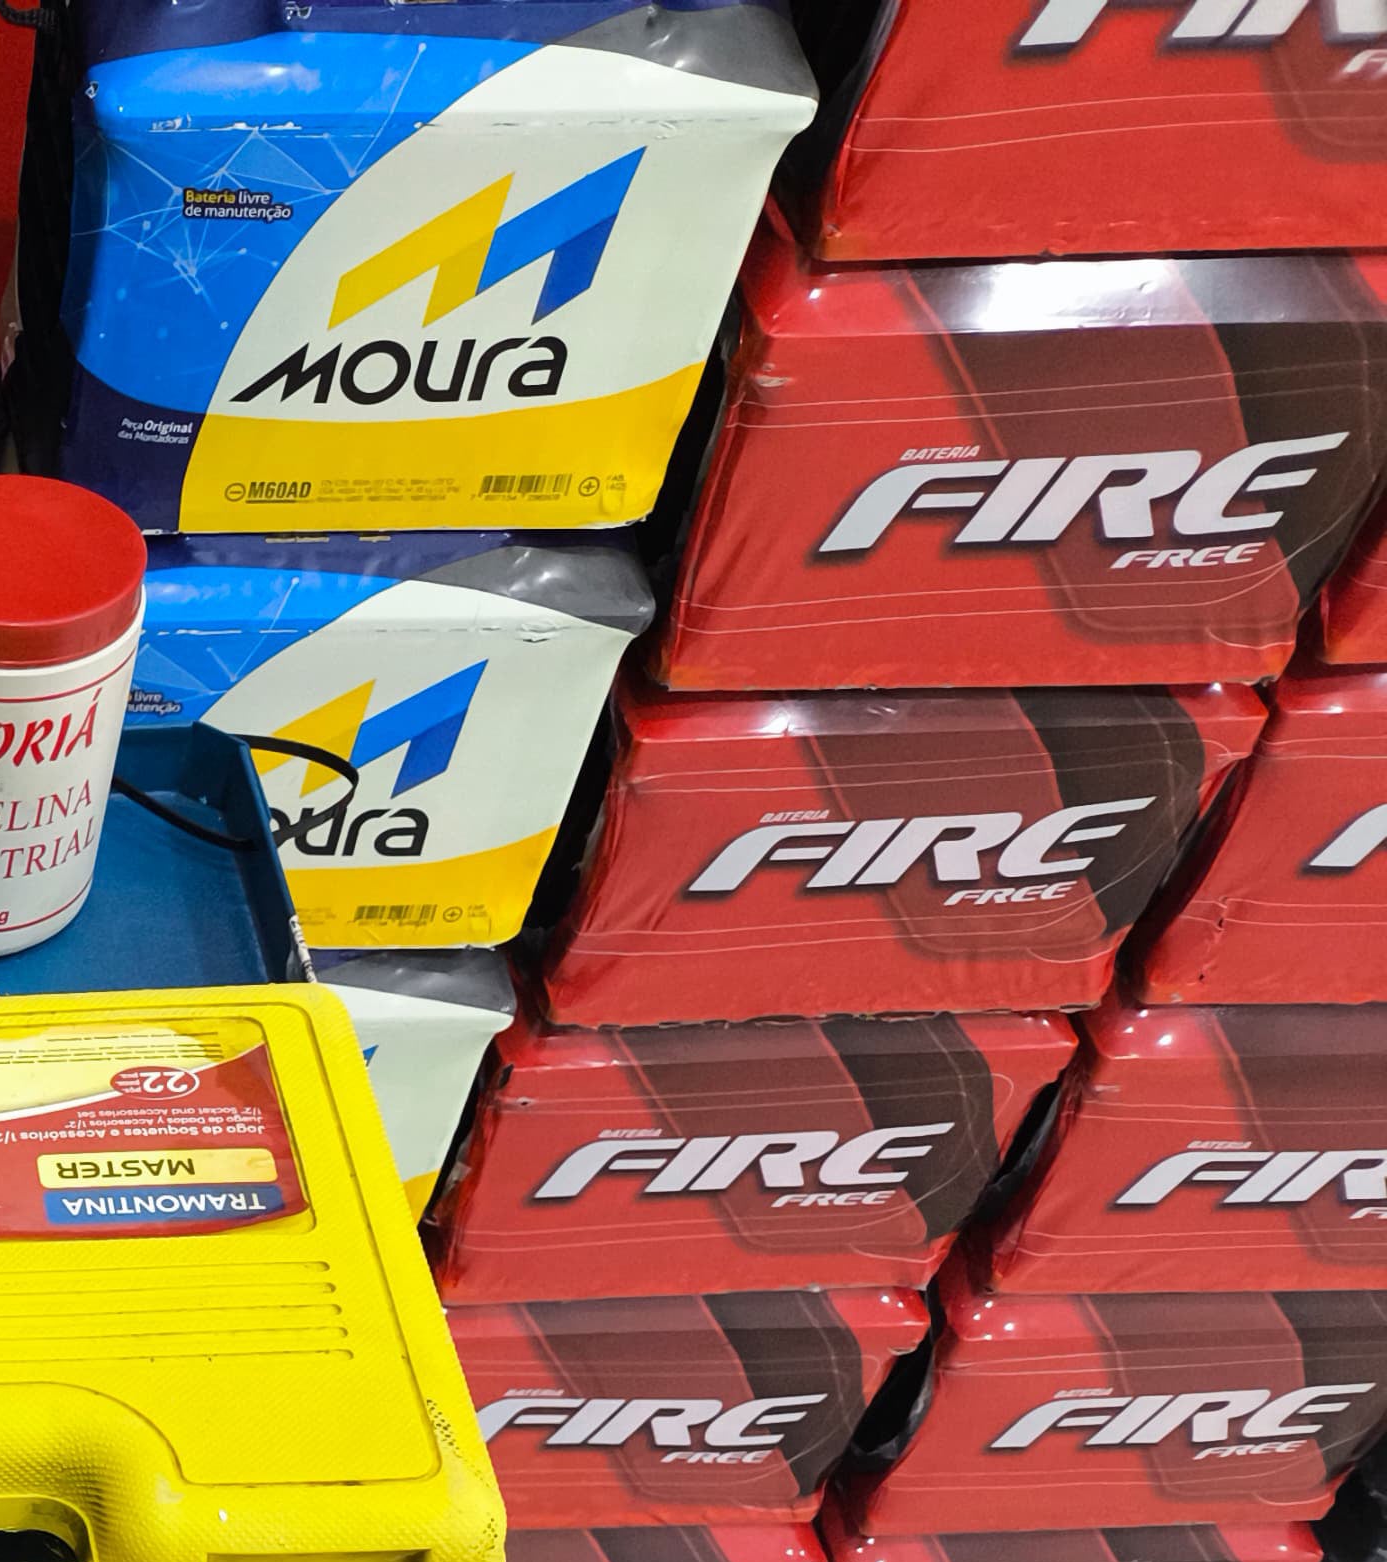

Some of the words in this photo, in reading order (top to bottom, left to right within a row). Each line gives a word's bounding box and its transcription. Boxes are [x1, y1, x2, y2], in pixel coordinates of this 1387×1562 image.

[184, 189, 235, 204] Bateria
[237, 190, 271, 204] livre
[184, 204, 202, 217] de
[205, 205, 291, 222] manutenção
[144, 419, 192, 436] Original
[899, 445, 981, 462] BATERIA
[248, 481, 312, 499] M60AD
[819, 431, 1350, 552] FIRE
[1111, 542, 1265, 569] FREE
[759, 809, 829, 824] BATERIA
[689, 796, 1157, 892] FIRE
[944, 881, 1077, 906] FREE
[139, 1070, 189, 1094] 22
[20, 1128, 107, 1143] Acessórios
[123, 1124, 199, 1138] Soquetes
[202, 1126, 223, 1136] de
[225, 1124, 266, 1135] Jogo
[56, 1158, 196, 1179] MASTER
[534, 1122, 955, 1199] FIRE
[61, 1192, 267, 1217] TRAMONTINA
[771, 1190, 896, 1208] FREE
[477, 1393, 829, 1447] FIRE
[991, 1383, 1376, 1448] FIRE
[661, 1450, 773, 1464] FREE
[1193, 1440, 1307, 1460] FREE
